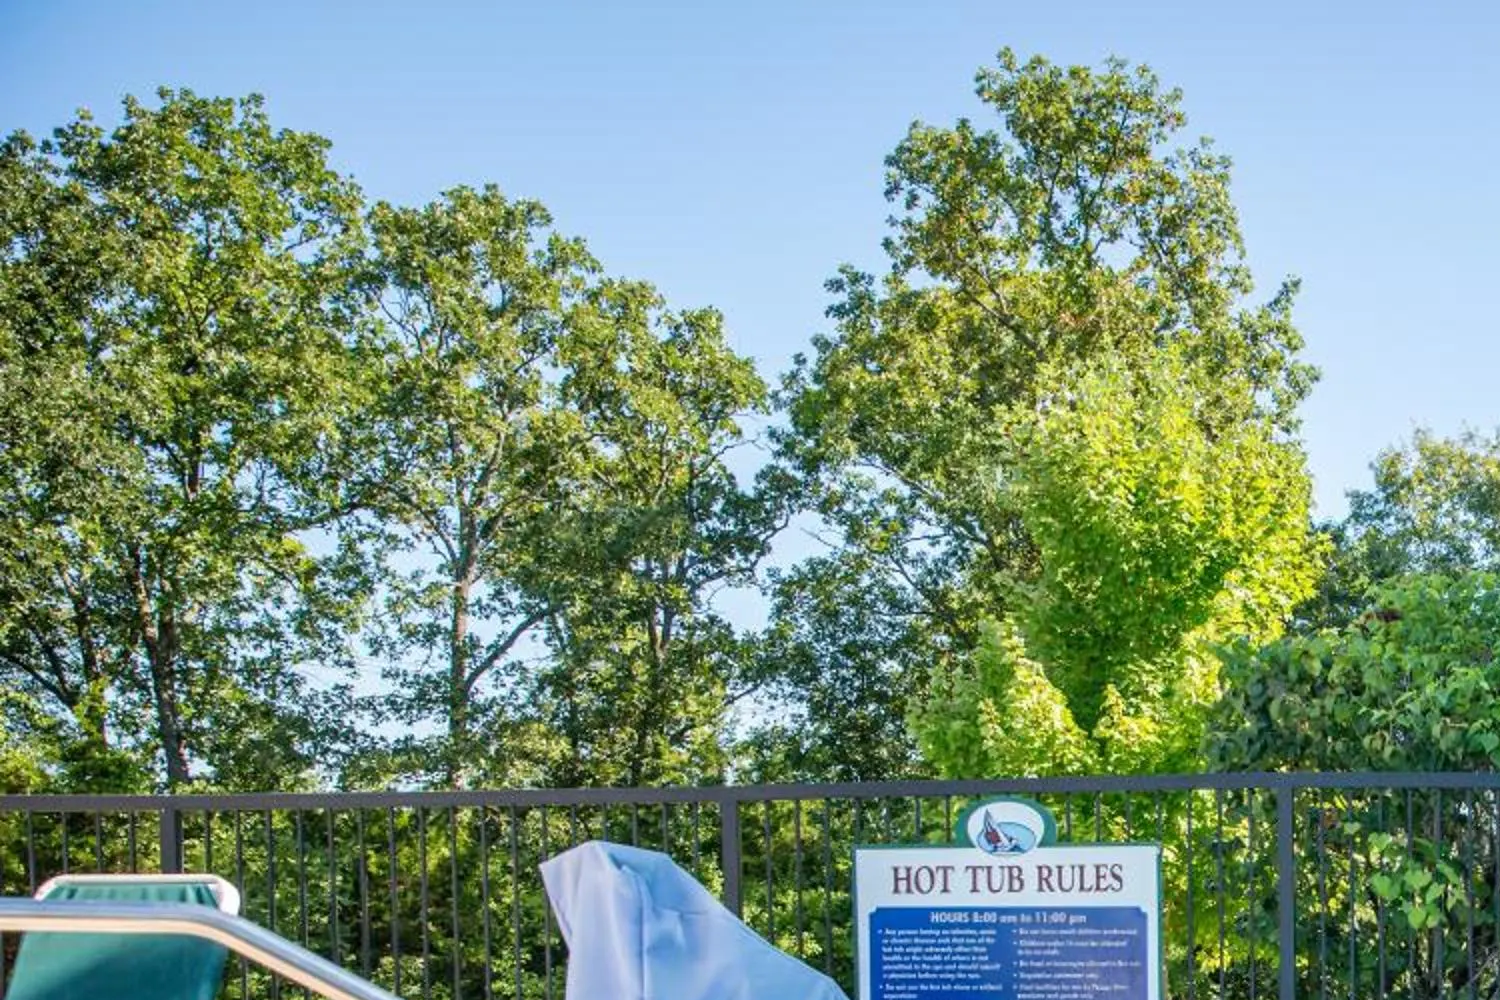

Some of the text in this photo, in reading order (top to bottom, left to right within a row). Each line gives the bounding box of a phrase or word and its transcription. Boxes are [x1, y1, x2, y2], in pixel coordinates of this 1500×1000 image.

[892, 863, 1123, 894] HOT TUB RULES
[930, 911, 1087, 925] HOURS 8:00 am to 11:00 pm
